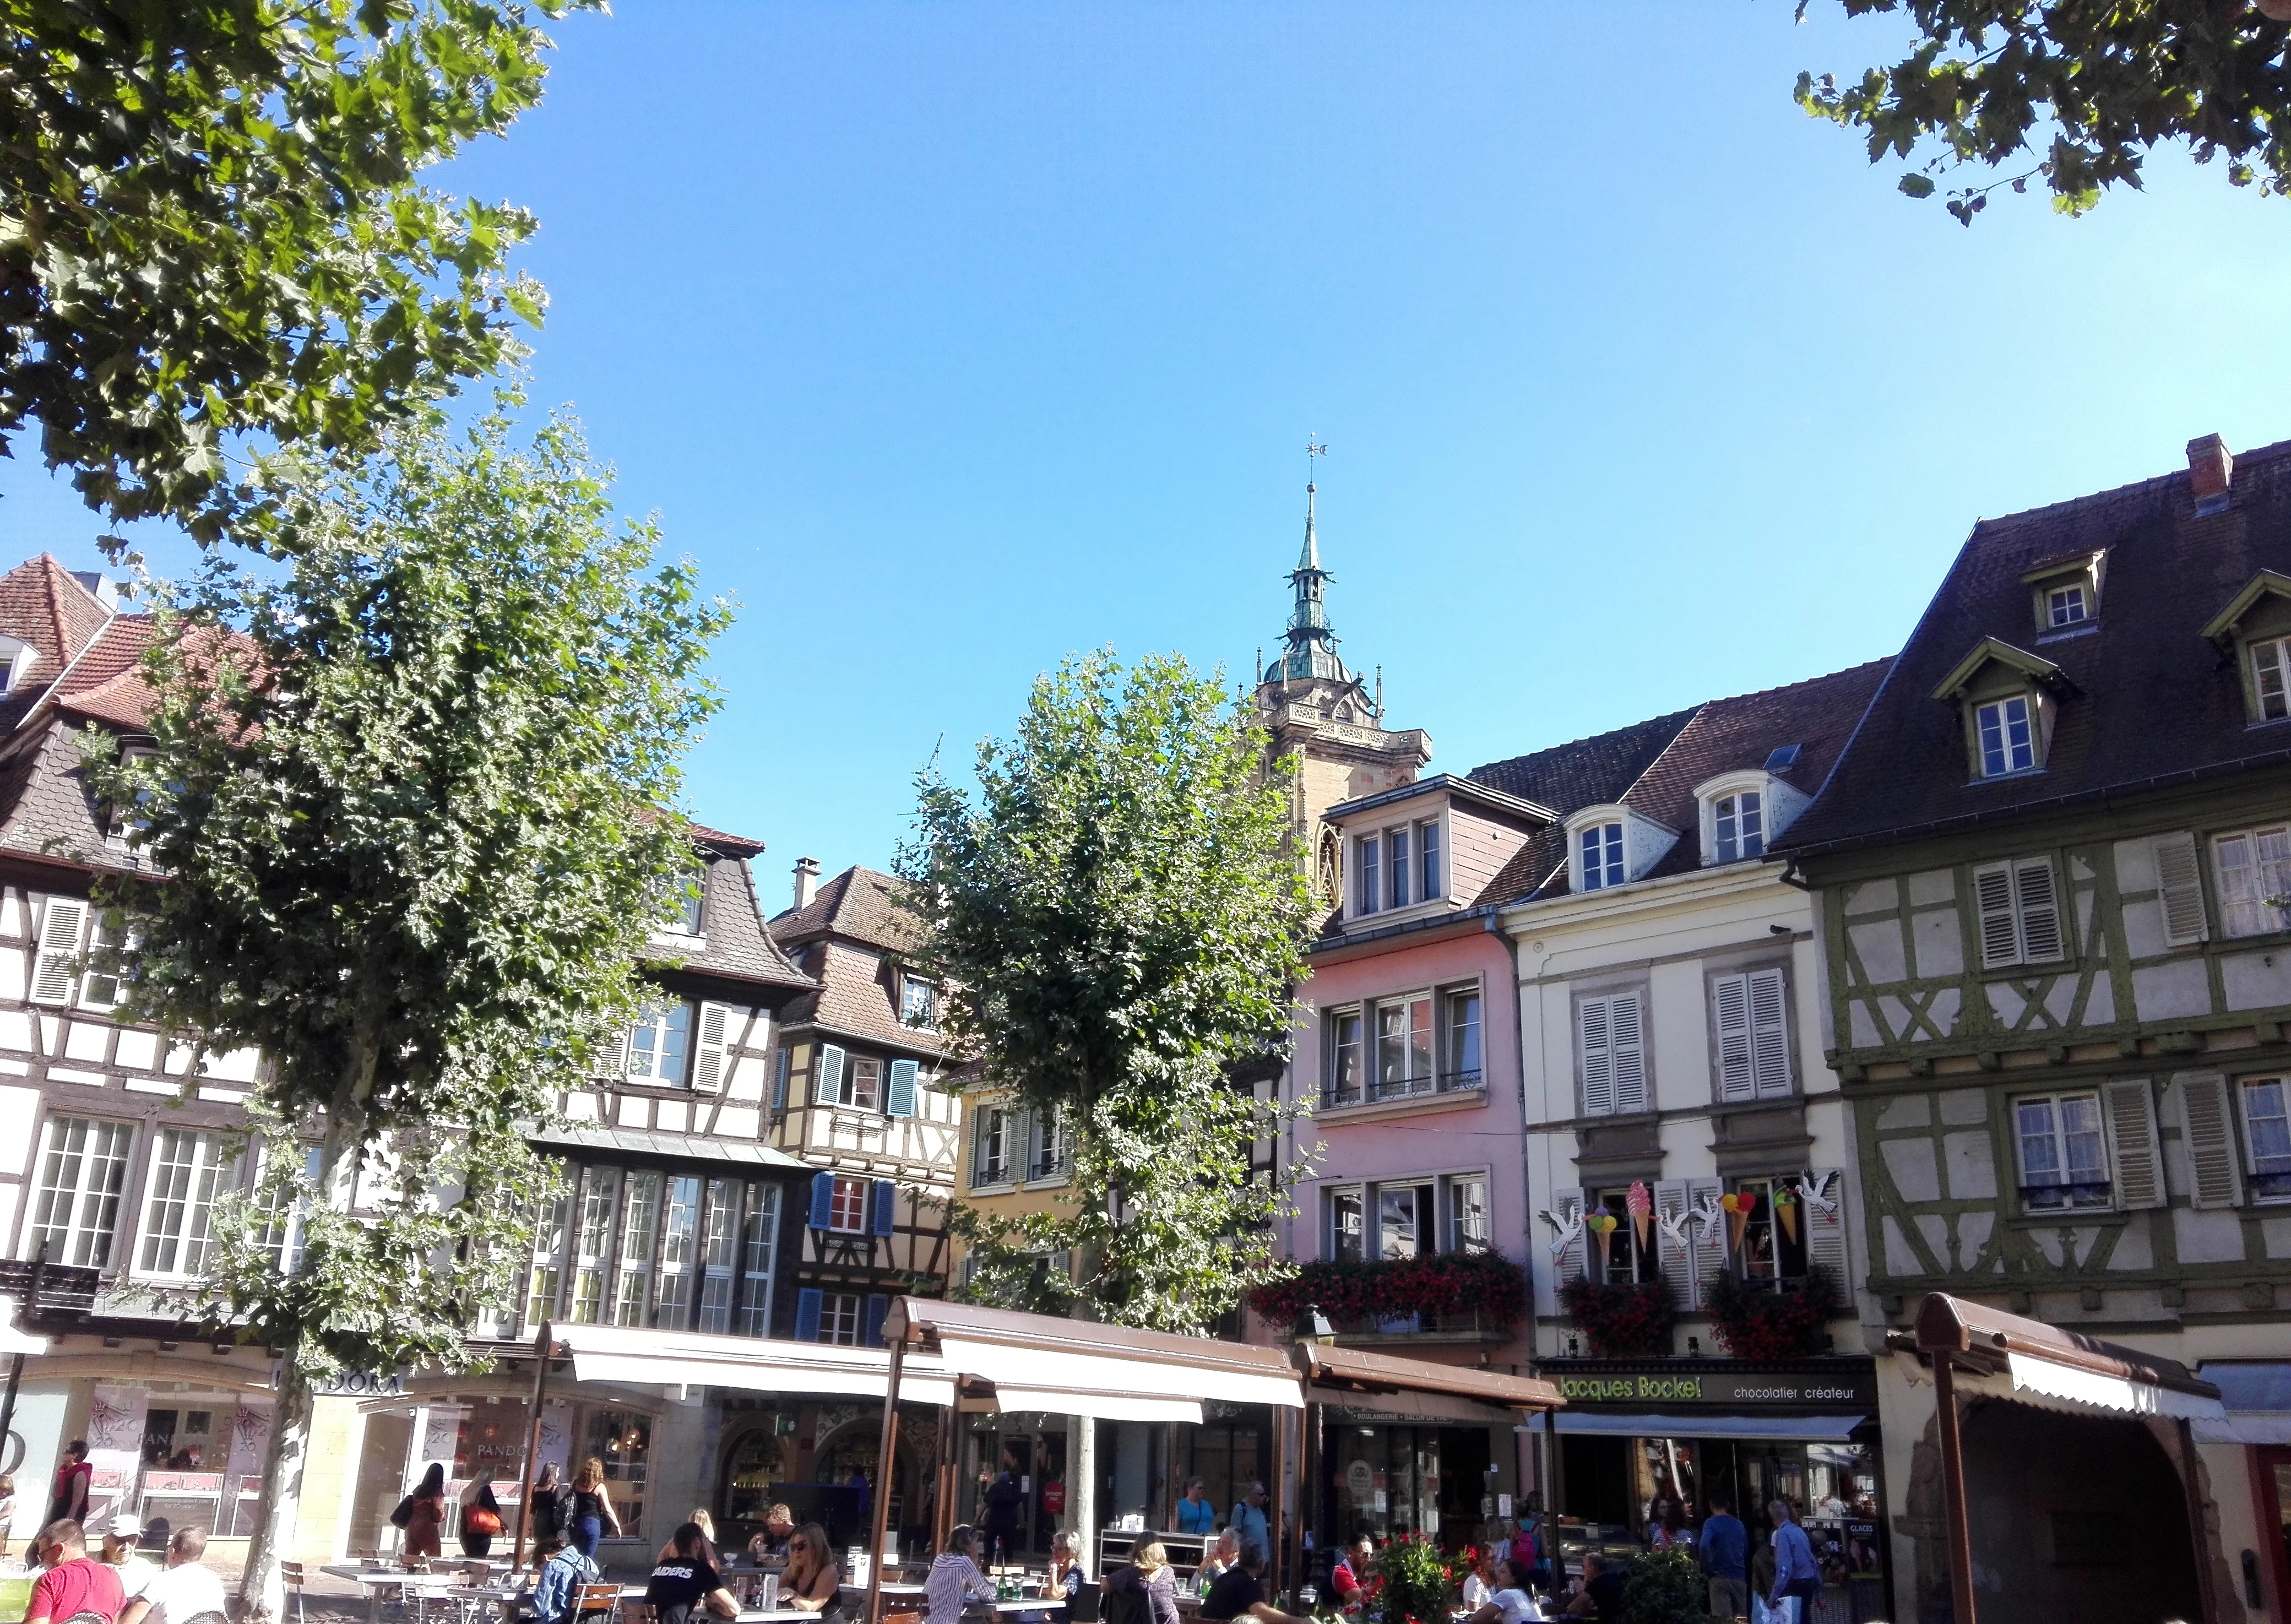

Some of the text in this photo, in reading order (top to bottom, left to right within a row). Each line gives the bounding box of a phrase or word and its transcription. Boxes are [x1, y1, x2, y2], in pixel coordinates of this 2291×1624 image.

[1559, 1376, 1701, 1401] Jacques Bockel
[1734, 1386, 1854, 1399] chocolatier créateur
[477, 1443, 527, 1457] PANDO
[652, 1566, 694, 1579] AIDERS
